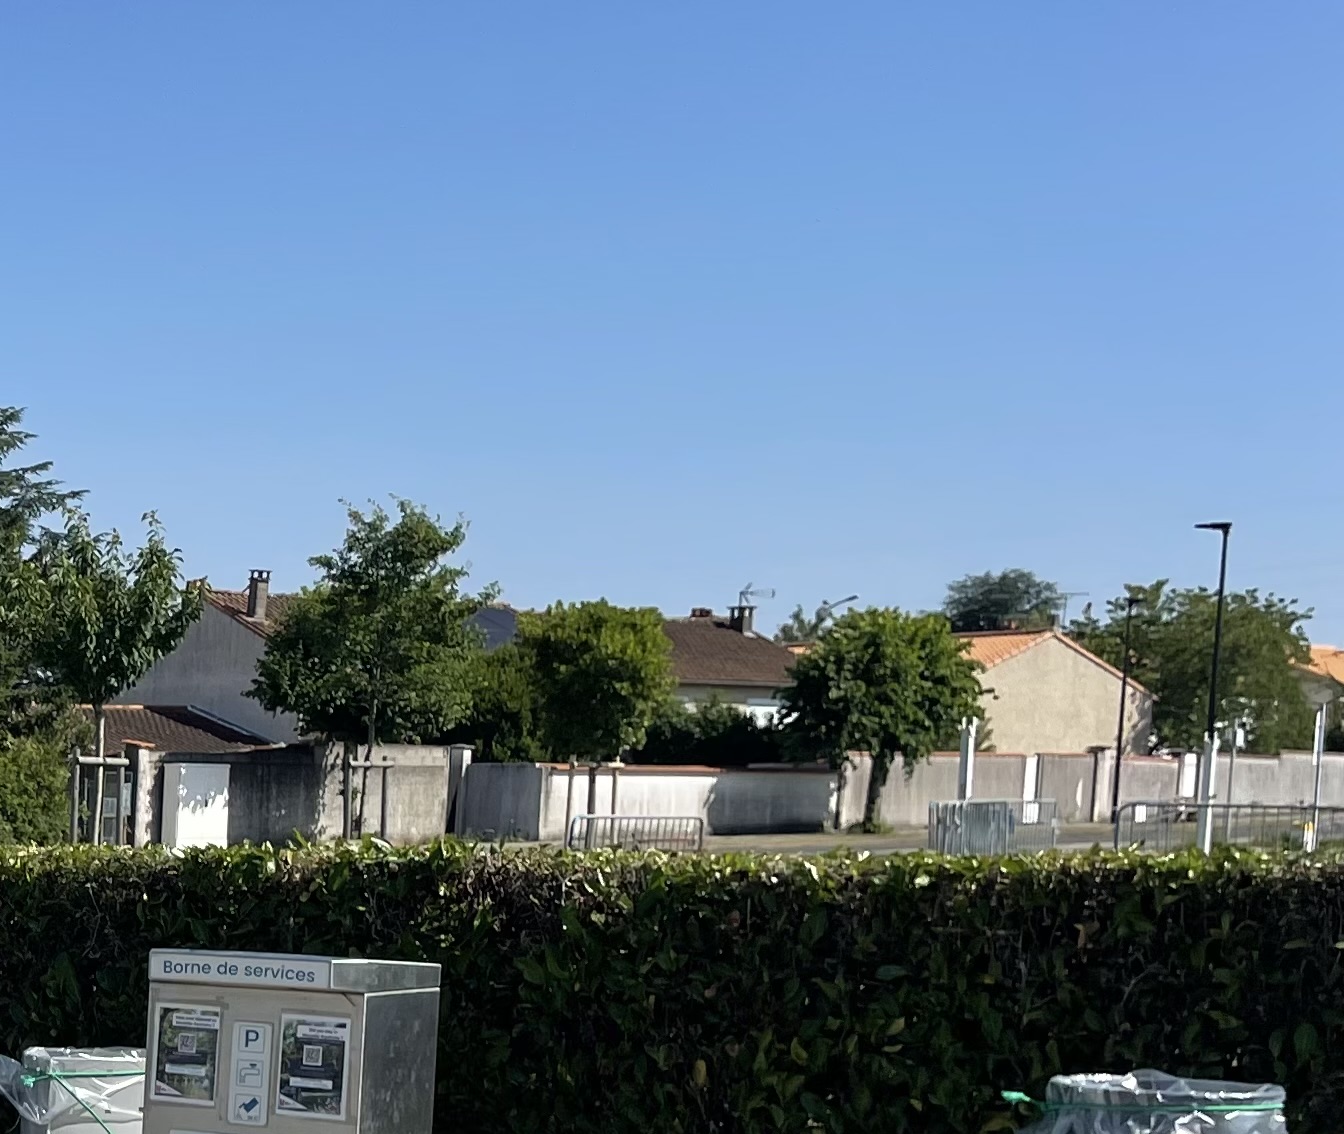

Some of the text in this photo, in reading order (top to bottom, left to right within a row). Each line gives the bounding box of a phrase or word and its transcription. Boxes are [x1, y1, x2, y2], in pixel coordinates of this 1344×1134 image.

[163, 960, 316, 982] Borne de services
[244, 1029, 260, 1048] P
